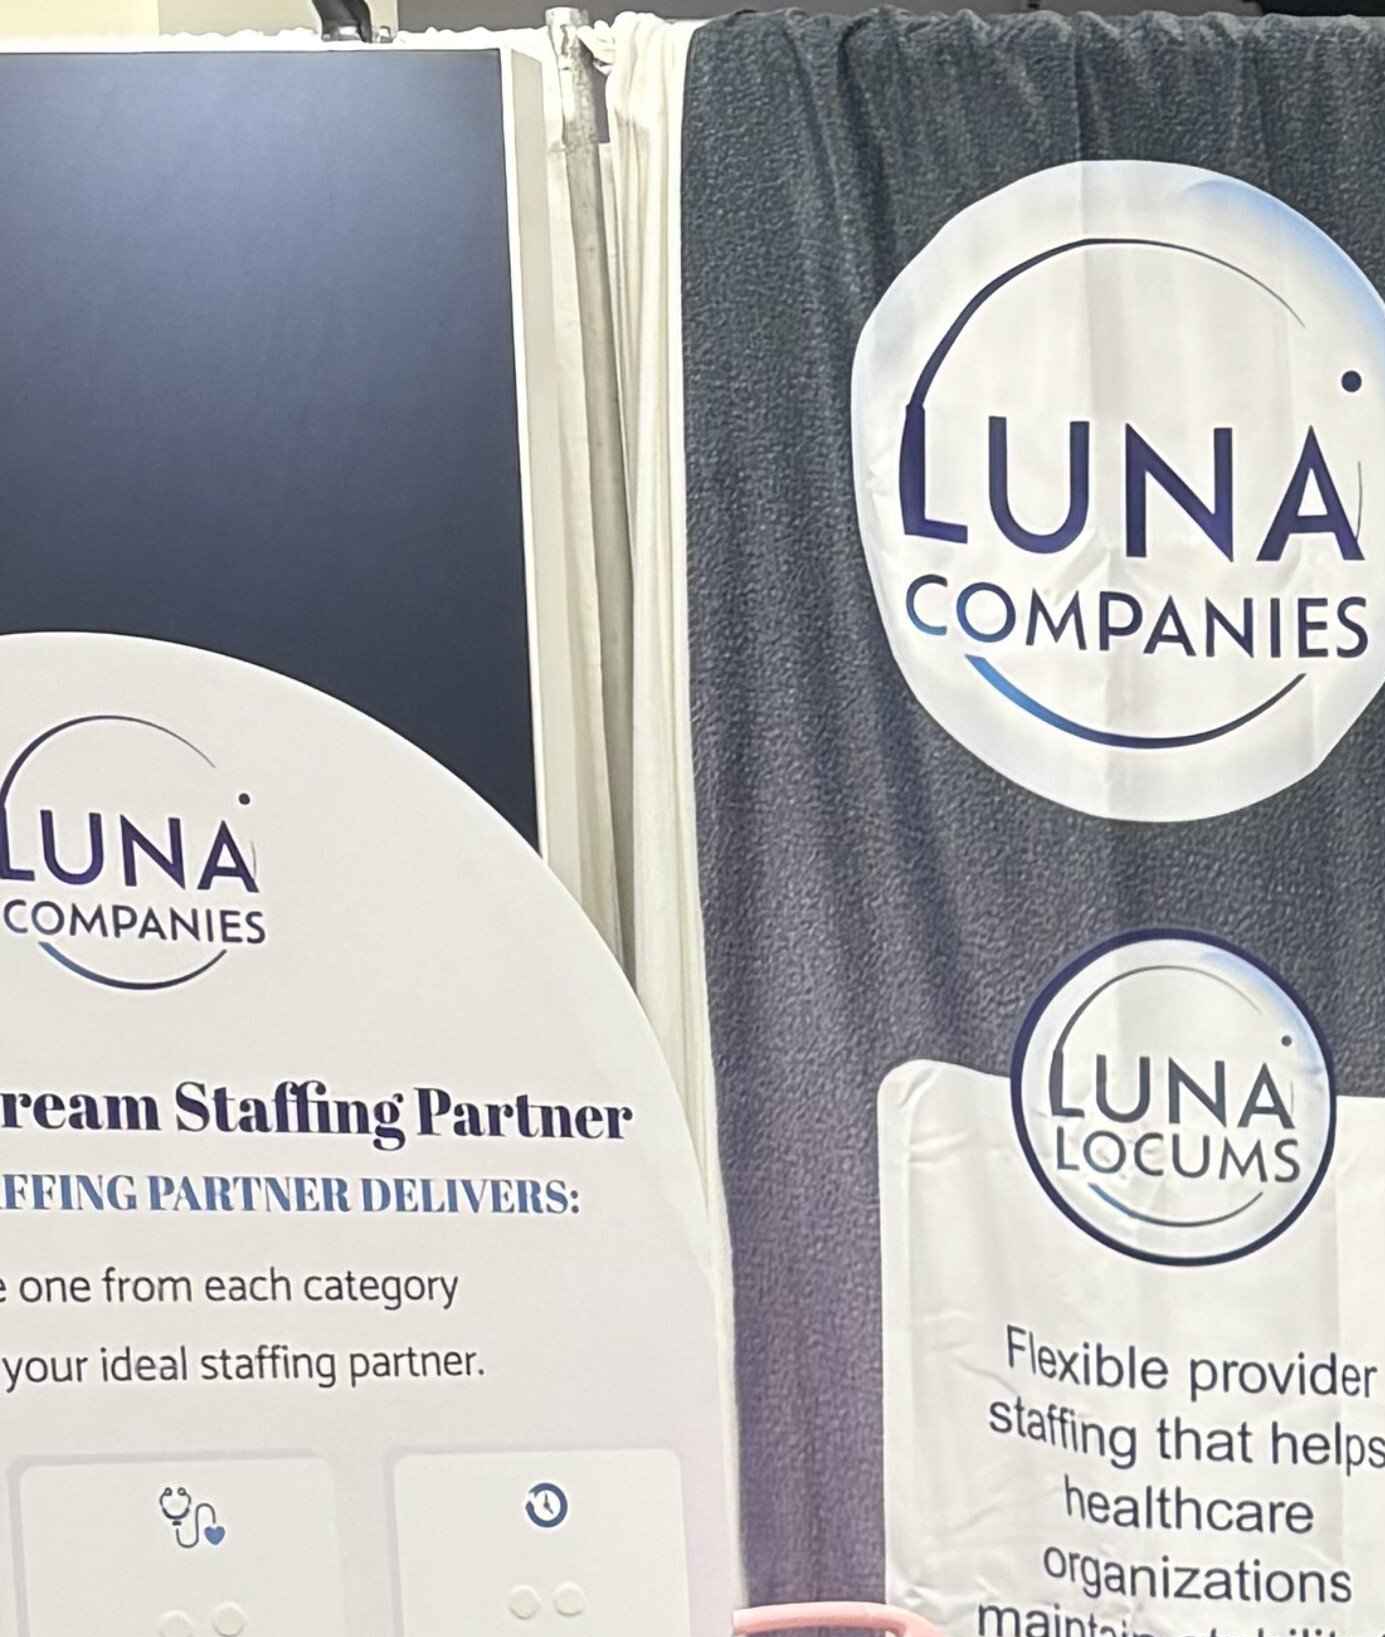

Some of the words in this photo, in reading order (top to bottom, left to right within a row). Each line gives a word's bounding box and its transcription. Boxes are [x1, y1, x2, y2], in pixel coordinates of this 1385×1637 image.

[899, 403, 1366, 563] LUNA
[905, 573, 1369, 658] COMPANIES
[0, 804, 260, 893] LUNA
[4, 898, 266, 944] COMPANIES
[0, 1092, 161, 1131] ream
[175, 1080, 405, 1150] Staffing
[413, 1087, 633, 1139] Partner
[1050, 1045, 1295, 1131] LUNA
[1055, 1126, 1301, 1183] LOCUMS
[0, 1174, 137, 1211] FFING
[146, 1175, 351, 1212] PARTNER
[359, 1177, 580, 1215] DELIVERS:
[19, 1275, 91, 1303] one
[102, 1266, 193, 1303] from
[205, 1266, 292, 1302] each
[304, 1270, 459, 1311] category
[0, 1356, 88, 1394] your
[100, 1345, 189, 1383] ideal
[200, 1344, 337, 1389] staffing
[350, 1347, 485, 1388] partner.
[1005, 1324, 1169, 1391] Flexible
[1189, 1351, 1378, 1402] provider
[988, 1395, 1138, 1469] staffing
[1157, 1418, 1253, 1465] that
[1064, 1476, 1316, 1534] healthcare
[1043, 1545, 1353, 1604] organizations
